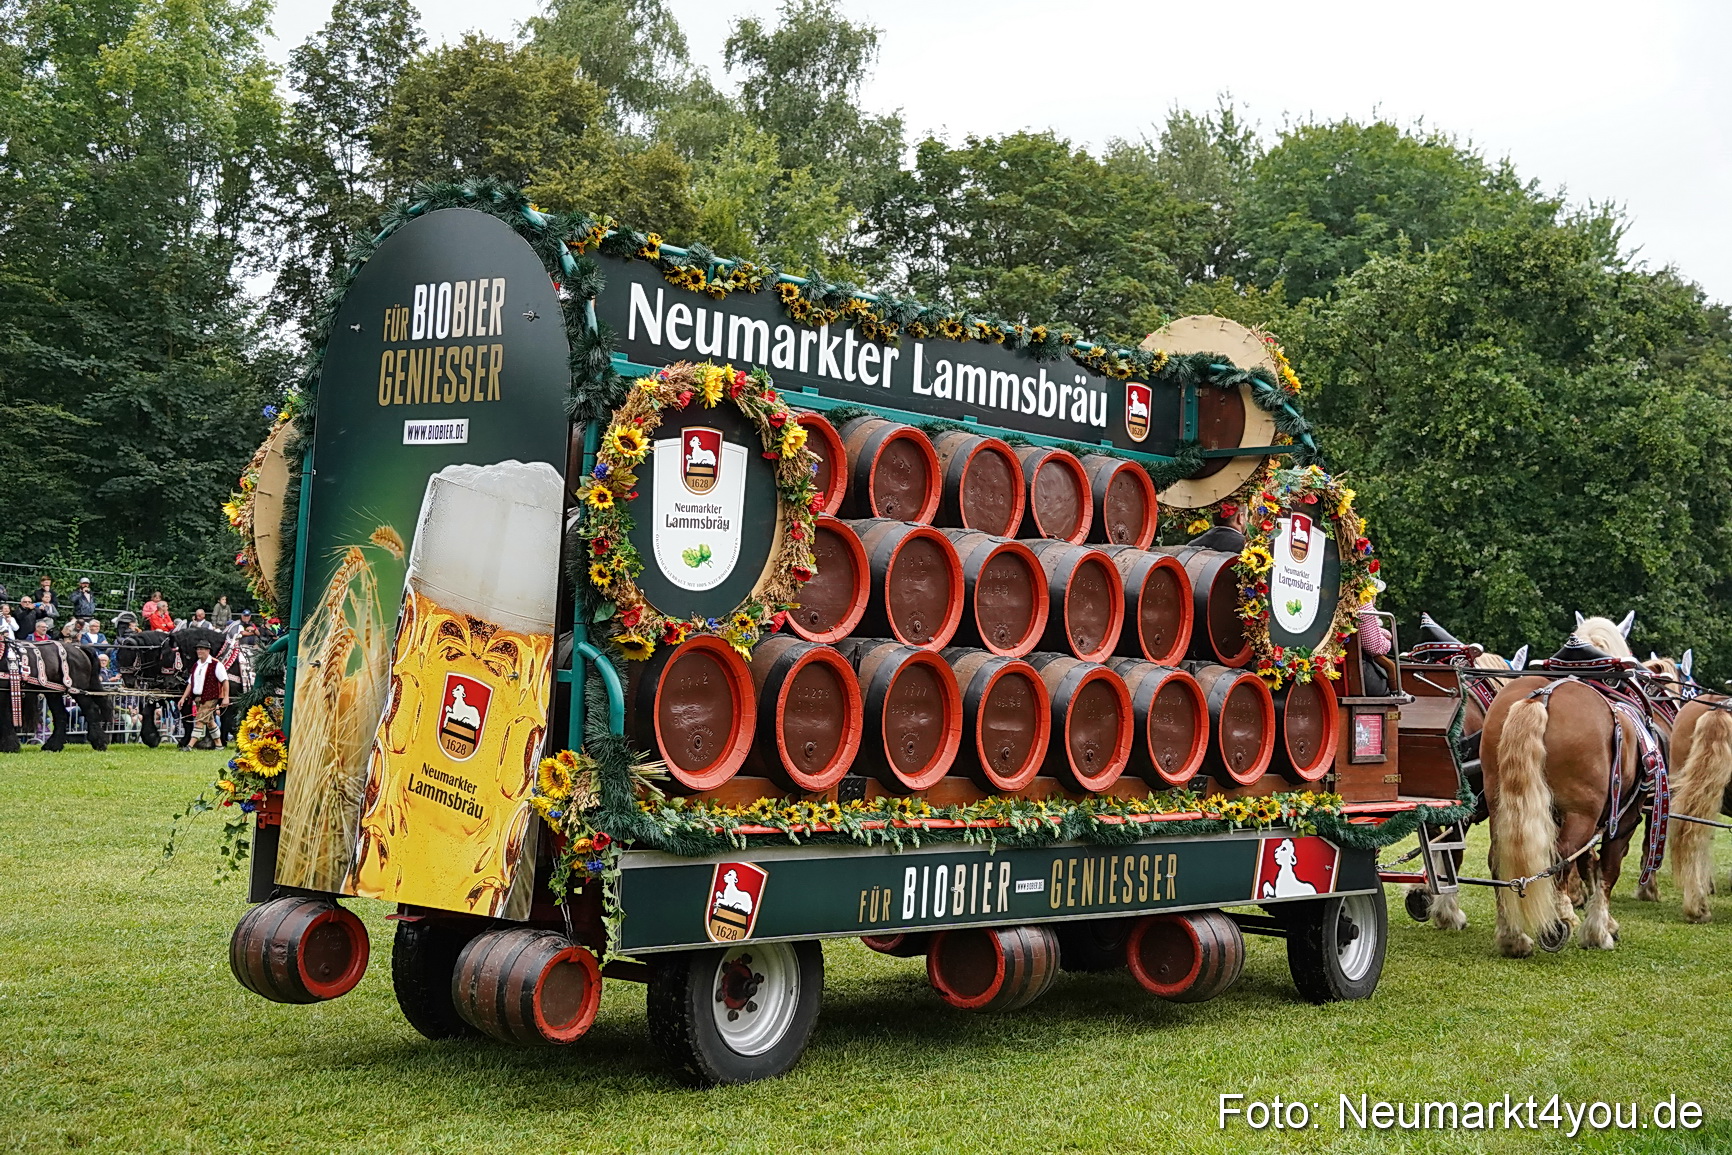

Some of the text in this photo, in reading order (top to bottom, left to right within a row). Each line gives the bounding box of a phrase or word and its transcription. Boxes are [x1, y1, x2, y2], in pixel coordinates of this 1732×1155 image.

[383, 277, 506, 342] FÜR BIOBIER
[628, 282, 1109, 428] Neumarkter Lammsbräu
[378, 343, 503, 407] GENIESSER
[407, 423, 465, 441] WWW.BIOBIER.DE
[691, 478, 709, 489] 1628
[674, 502, 722, 515] Neumarkter
[665, 514, 730, 531] Lammsbräu
[445, 738, 467, 756] 1628
[421, 762, 478, 795] Neumarkter
[407, 773, 484, 820] Lammsbräu
[858, 885, 892, 923] FÜR
[902, 861, 1011, 920] BIOBIER
[1050, 853, 1178, 909] GENIESSER
[715, 924, 738, 940] 1628
